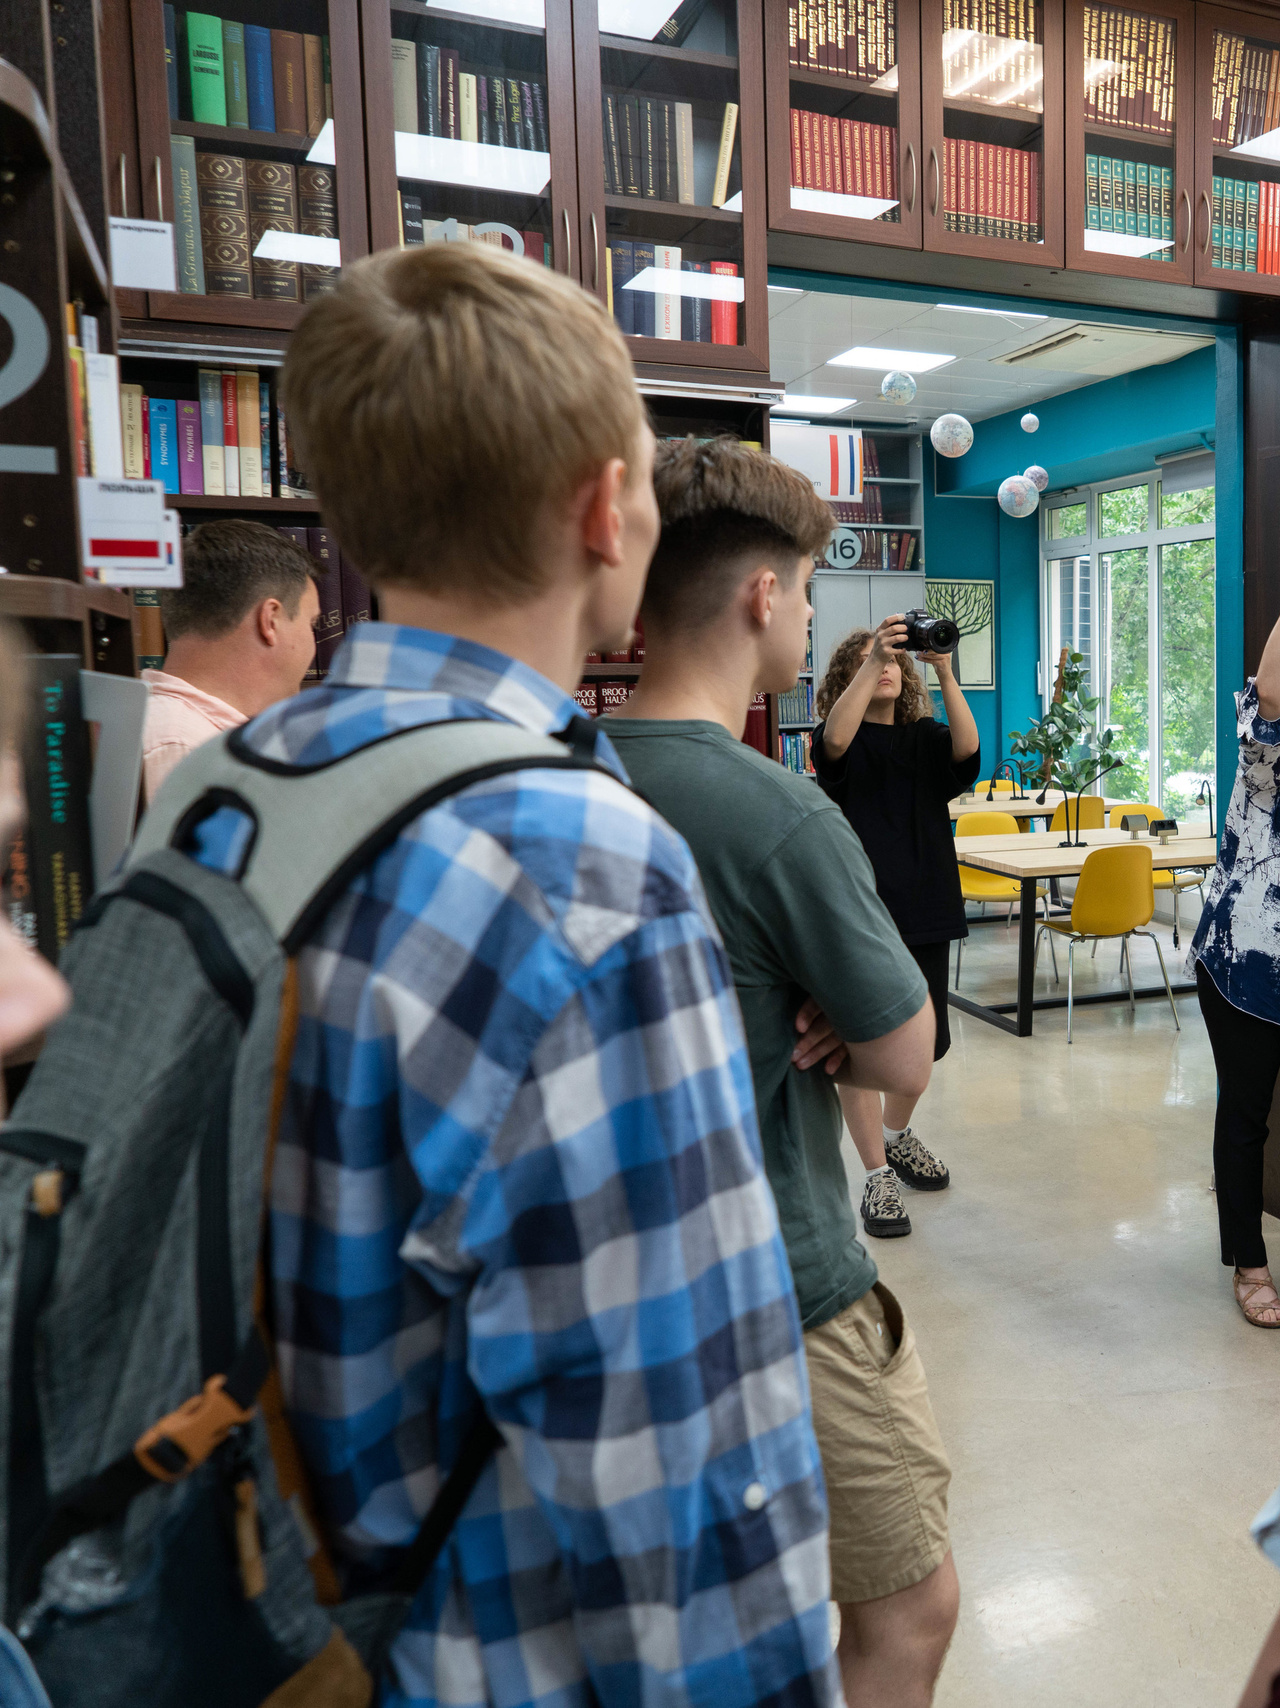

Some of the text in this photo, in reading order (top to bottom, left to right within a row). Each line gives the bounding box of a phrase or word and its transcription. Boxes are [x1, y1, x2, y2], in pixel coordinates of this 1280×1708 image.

[509, 80, 521, 123] Prinz Eugen
[794, 149, 802, 183] BRITANNICA
[834, 156, 842, 191] BRITANNICA
[178, 167, 198, 292] La Gravure, Art Majeur
[950, 214, 956, 222] 14
[715, 267, 734, 275] NEUES
[224, 380, 235, 427] homonymes
[160, 423, 169, 466] SYNONYMES
[186, 424, 195, 463] PROVERBES
[320, 534, 327, 542] 2
[829, 538, 856, 560] 16
[573, 698, 596, 706] HAUS
[602, 687, 628, 697] BROCK
[605, 695, 628, 704] HAUS
[44, 680, 71, 825] To Paradise
